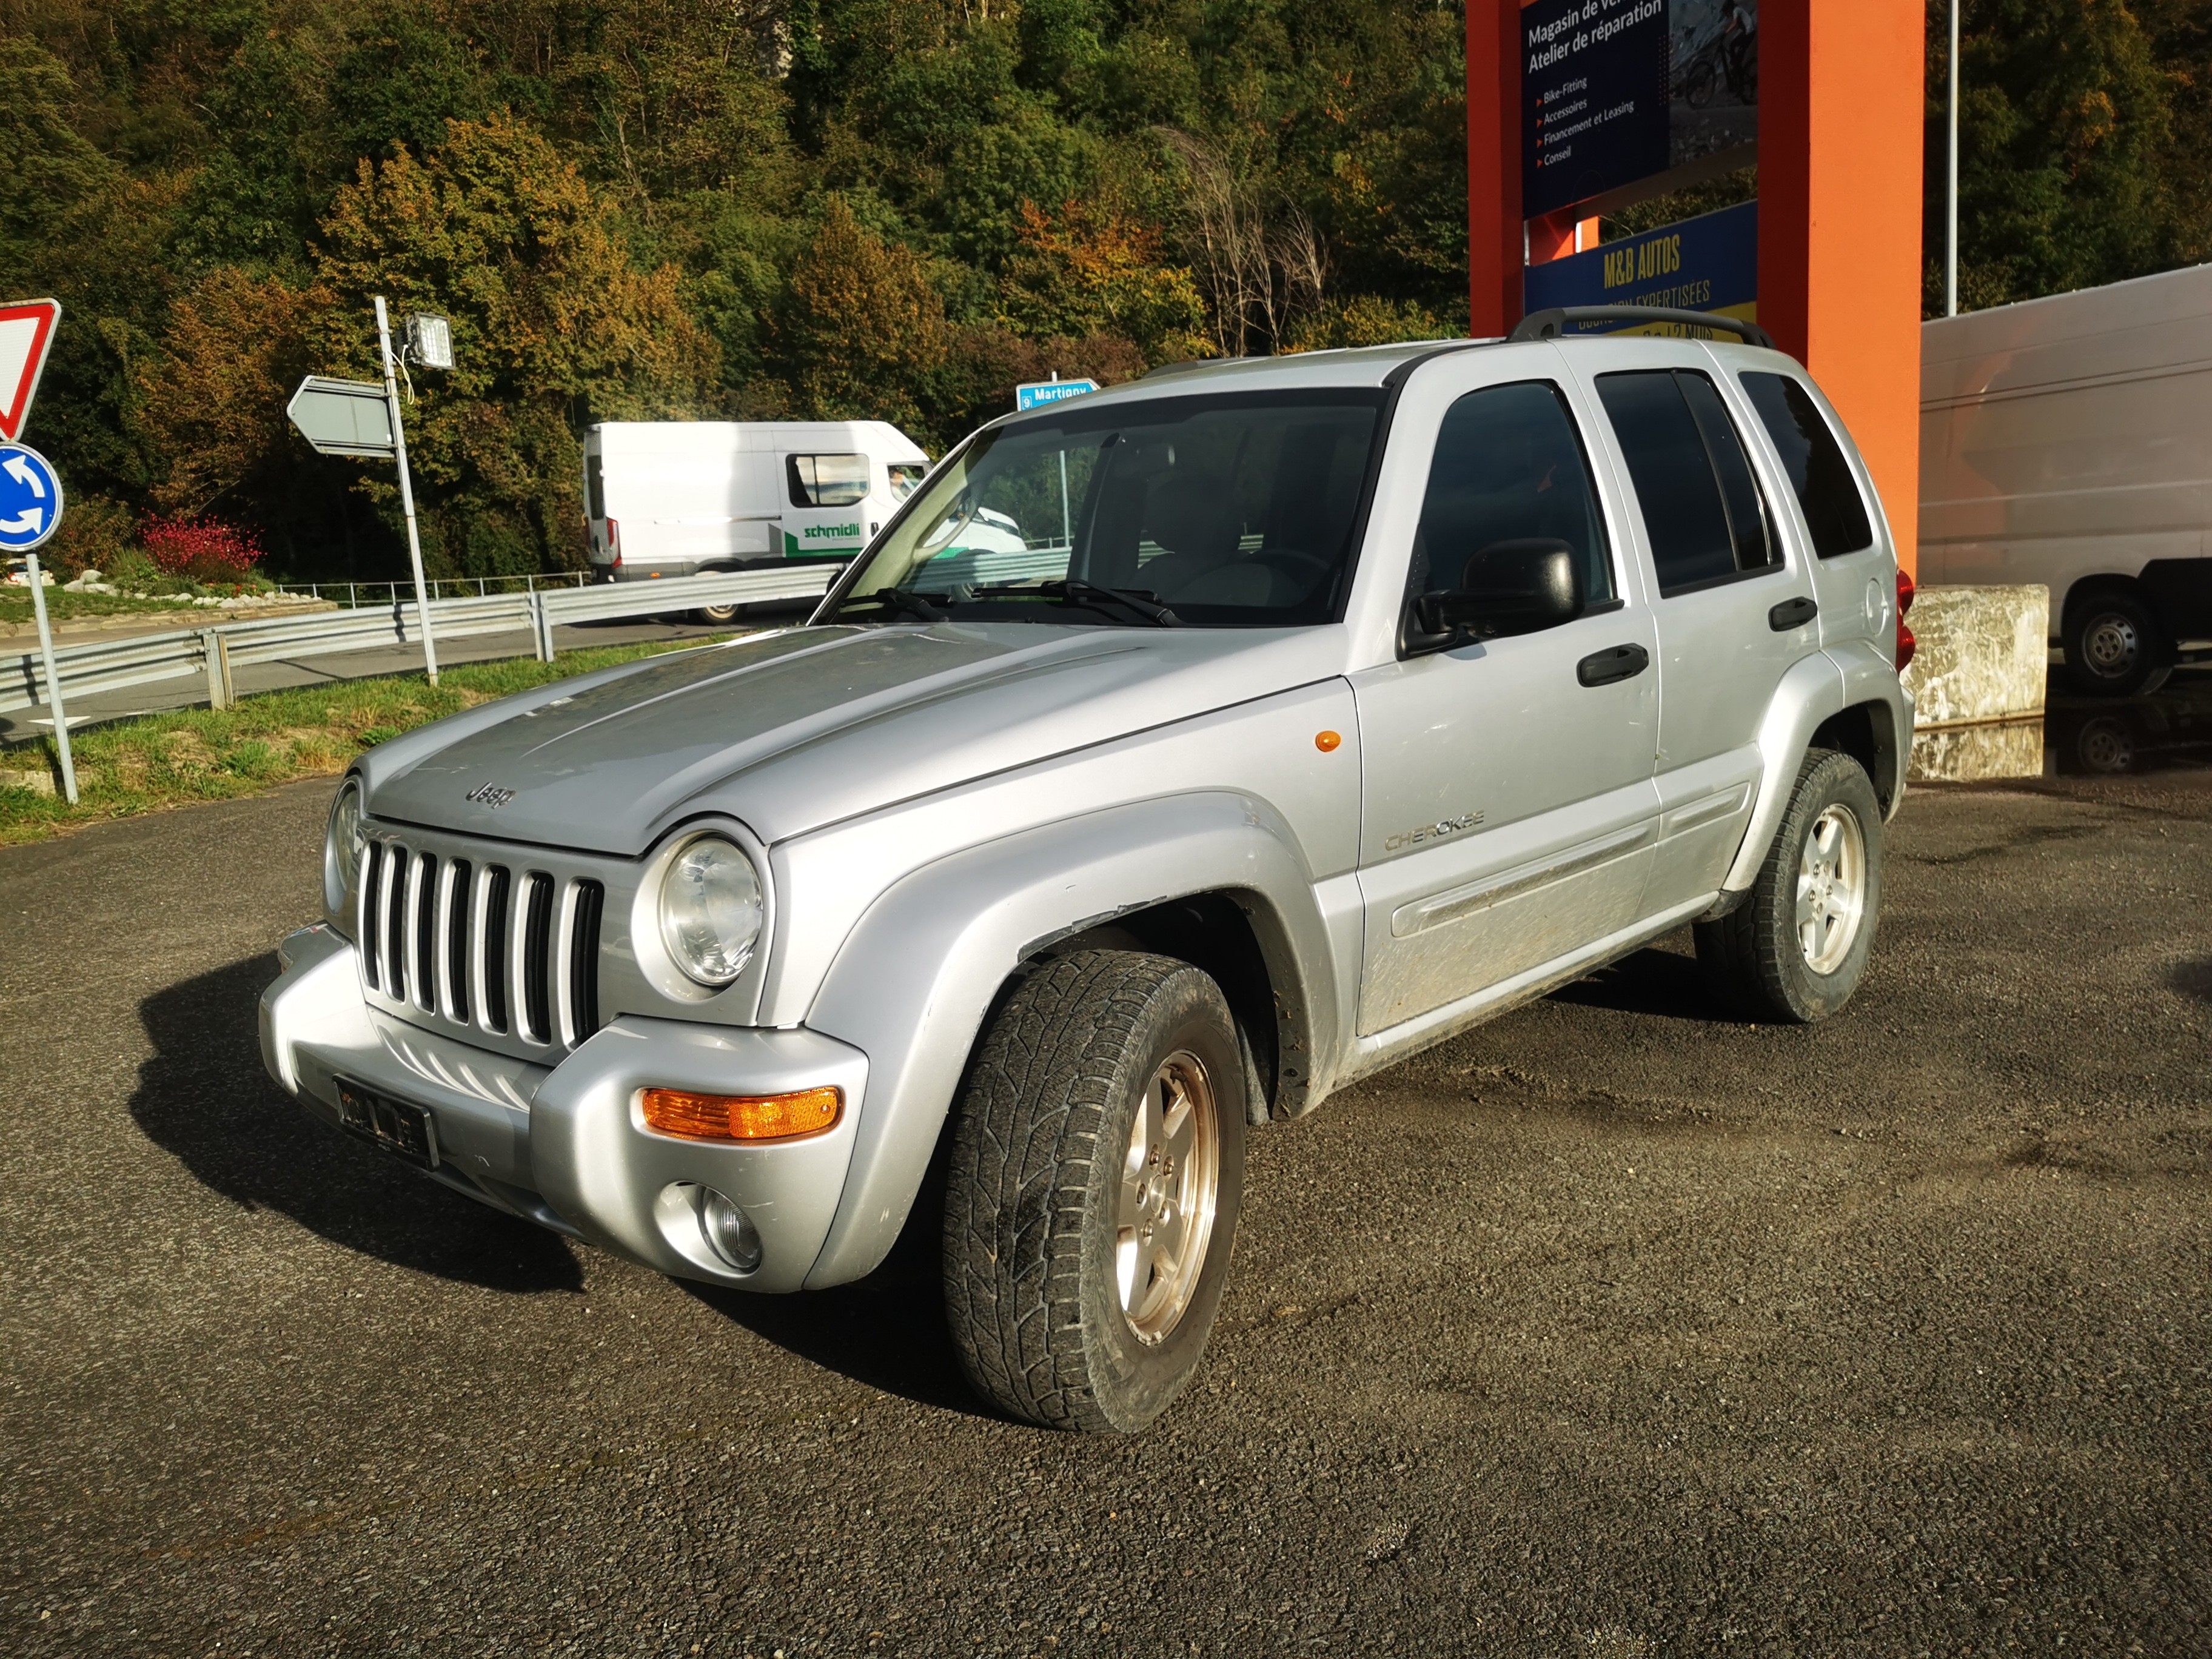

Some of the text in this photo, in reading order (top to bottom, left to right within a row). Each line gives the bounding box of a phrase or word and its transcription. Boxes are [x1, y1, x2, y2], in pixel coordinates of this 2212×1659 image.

[1528, 0, 1598, 48] Magasin de
[1528, 0, 1661, 74] Atelier de réparation
[1543, 78, 1587, 104] Bike-Fitting
[1544, 99, 1587, 126] Accessoires
[1544, 101, 1634, 146] Financement et Leasing
[1544, 145, 1571, 166] Conseil
[1604, 234, 1680, 289] M&B AUTOS
[1024, 398, 1030, 407] 9
[804, 523, 860, 538] schmidli
[466, 782, 516, 809] Jeep
[1385, 809, 1484, 851] CHEROKEE
